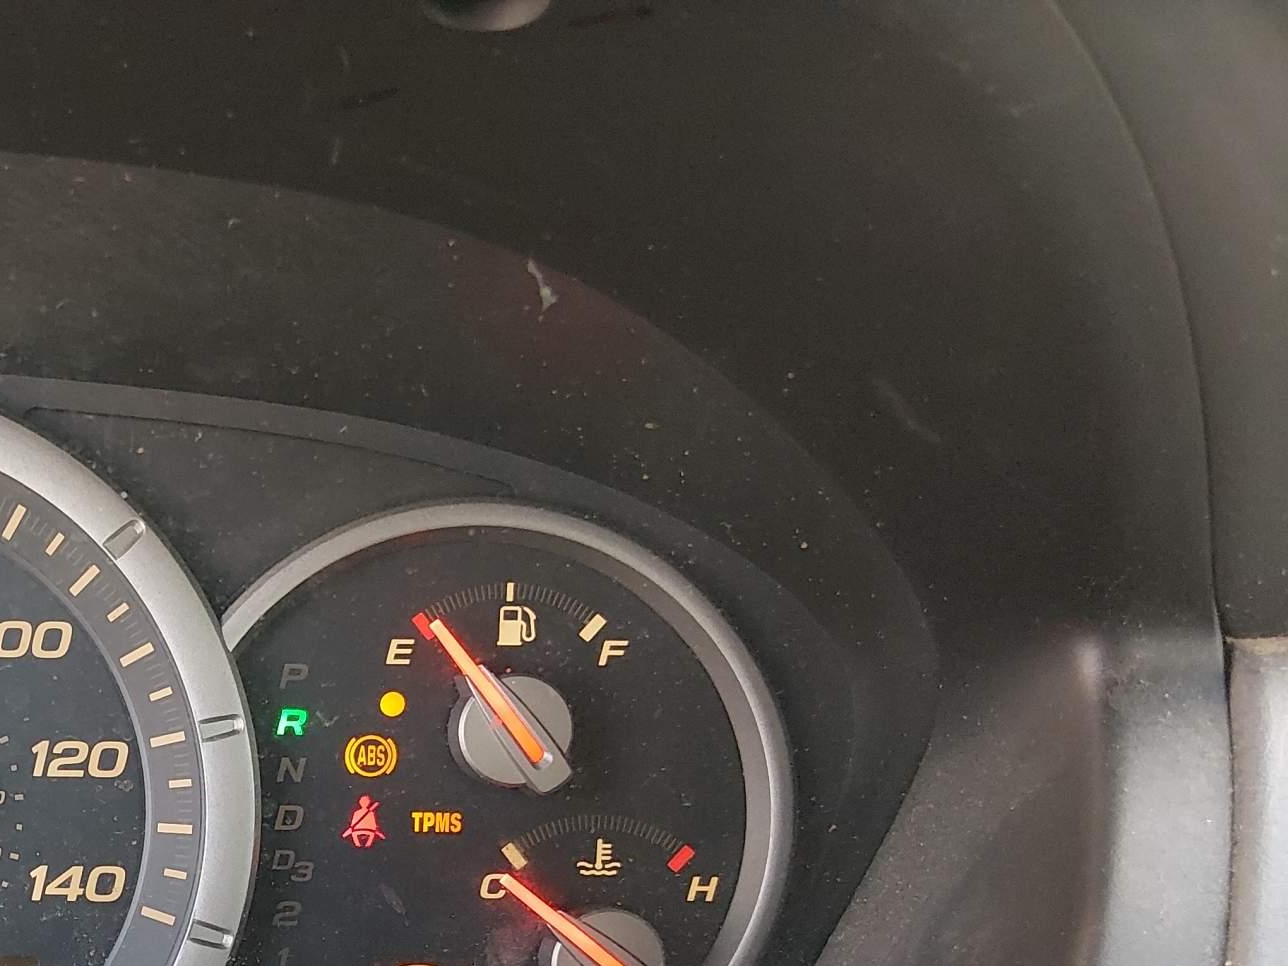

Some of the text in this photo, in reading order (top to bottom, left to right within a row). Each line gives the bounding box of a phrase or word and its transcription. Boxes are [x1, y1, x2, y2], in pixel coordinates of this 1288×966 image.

[385, 638, 414, 665] E
[598, 640, 628, 666] F
[280, 664, 309, 689] P
[276, 708, 309, 736] R
[30, 740, 129, 778] 120
[357, 745, 386, 766] ABS
[276, 757, 306, 782] N
[275, 805, 304, 831] D
[411, 811, 462, 833] TPMS
[29, 865, 127, 902] 140
[480, 873, 507, 899] C
[687, 877, 719, 901] H
[273, 901, 301, 927] 2
